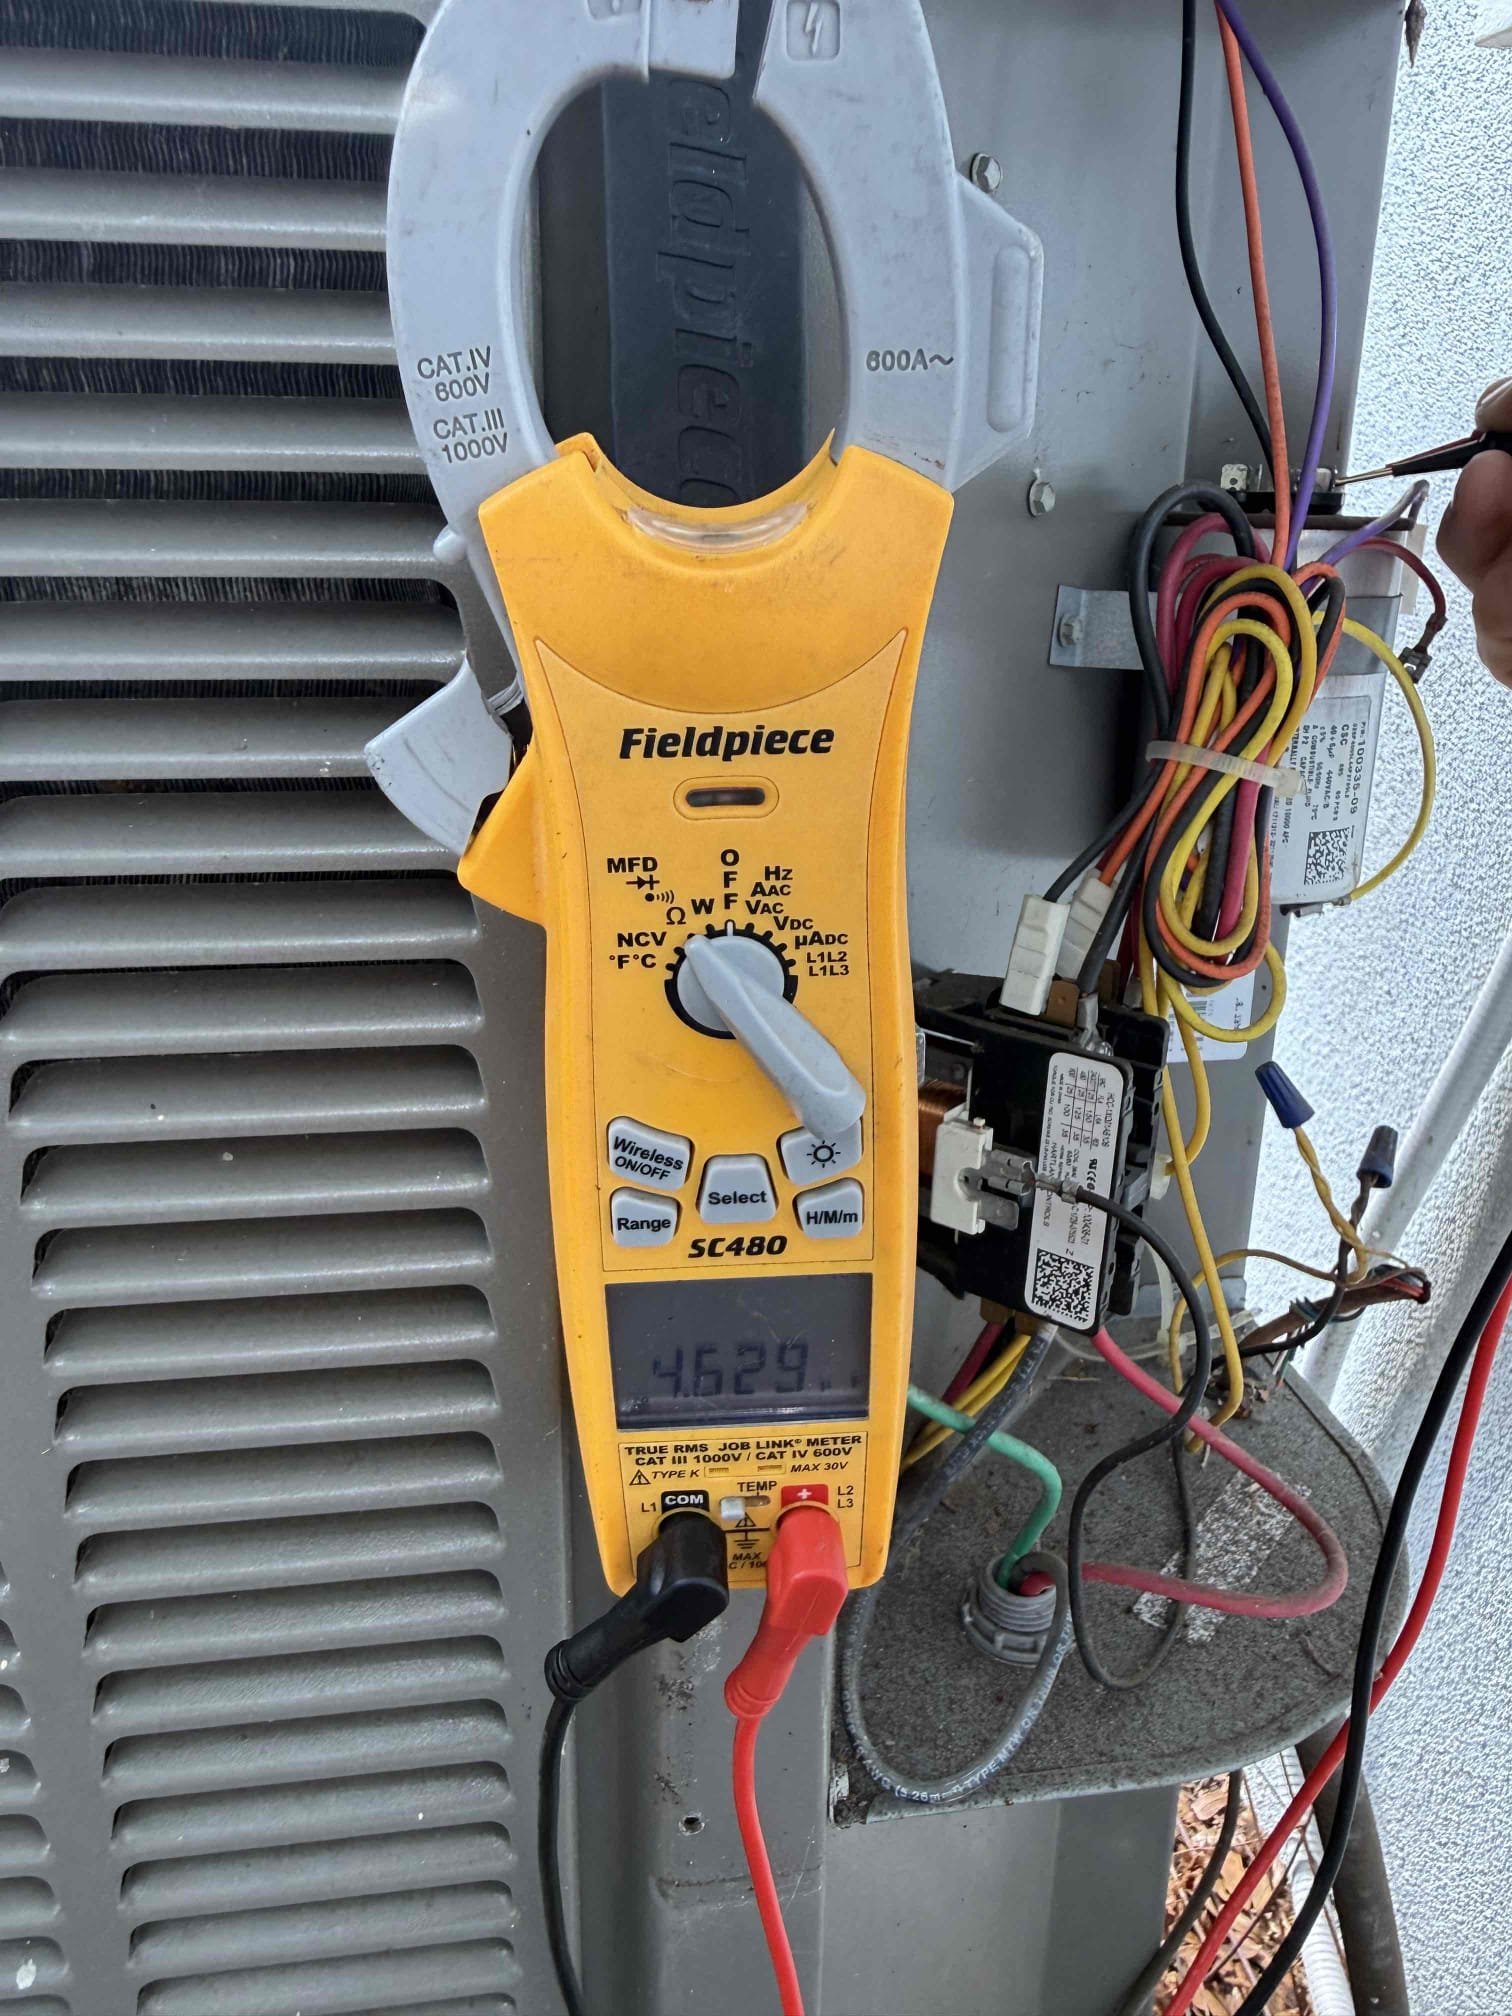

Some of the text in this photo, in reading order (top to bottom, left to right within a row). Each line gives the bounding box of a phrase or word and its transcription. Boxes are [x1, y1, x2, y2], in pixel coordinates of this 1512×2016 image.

[417, 346, 491, 380] CAT.IV
[435, 372, 491, 402] 600V
[433, 407, 505, 440] CAT.III
[441, 431, 509, 463] 1000V
[1340, 723, 1349, 746] CSC
[619, 725, 835, 762] Fieldpiece
[607, 856, 658, 873] MFD
[691, 899, 714, 915] W
[617, 932, 667, 947] NCV
[806, 951, 848, 963] L1L2
[808, 965, 850, 977] L1L3
[613, 1136, 684, 1171] Wireless
[615, 1155, 670, 1181] ON/OFF
[708, 1190, 768, 1205] Select
[617, 1217, 671, 1233] Range
[806, 1210, 858, 1225] H/M/m
[688, 1235, 788, 1258] SC480
[624, 1445, 669, 1456] TRUE
[674, 1443, 709, 1454] RMS
[718, 1440, 751, 1452] JOB
[807, 1435, 862, 1447] METER
[635, 1455, 669, 1467] CAT
[672, 1454, 688, 1465] III
[693, 1452, 743, 1464] 1000V
[756, 1450, 790, 1461] CAT
[792, 1449, 808, 1460] IV
[813, 1447, 853, 1459] 600V
[651, 1468, 700, 1480] TYPE K
[790, 1461, 849, 1473] MAX 30V
[737, 1480, 778, 1493] TEMP
[837, 1485, 854, 1496] L2
[641, 1502, 656, 1513] L1
[665, 1494, 704, 1505] COM
[837, 1499, 854, 1509] L3
[733, 1552, 761, 1560] MAX
